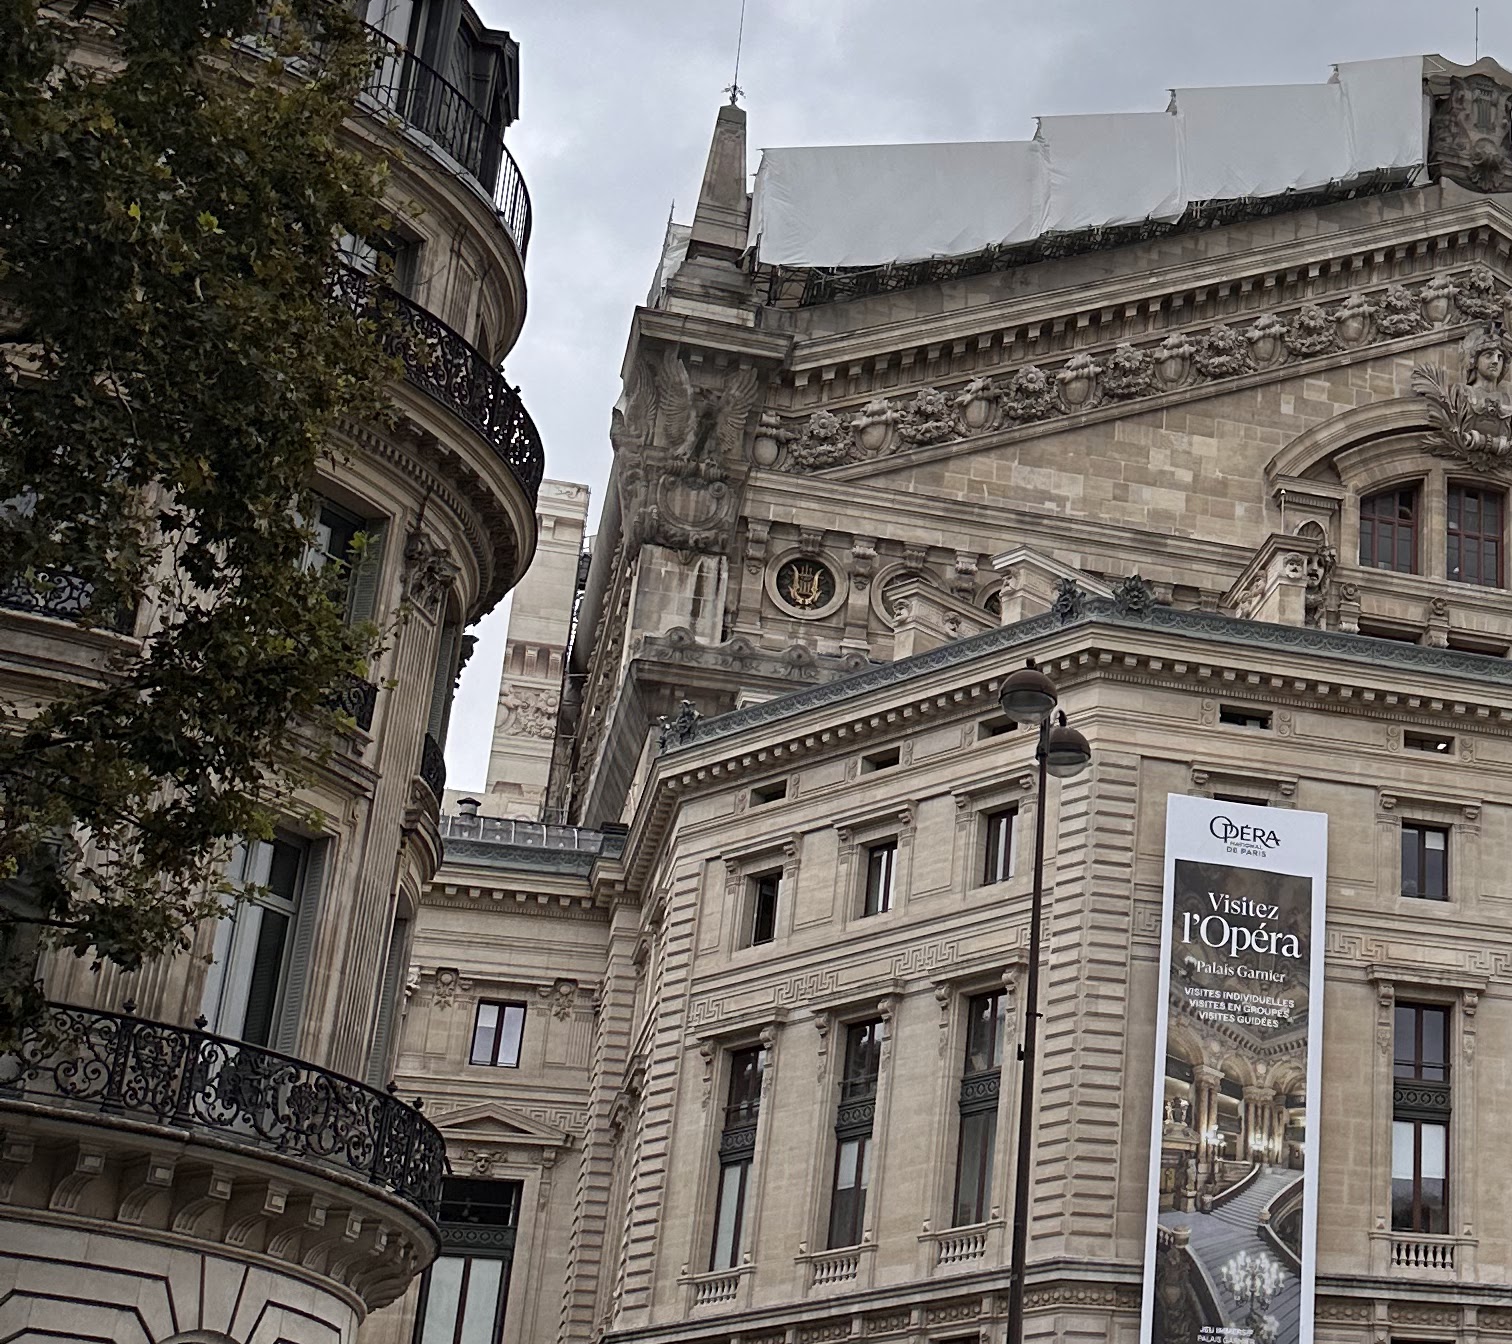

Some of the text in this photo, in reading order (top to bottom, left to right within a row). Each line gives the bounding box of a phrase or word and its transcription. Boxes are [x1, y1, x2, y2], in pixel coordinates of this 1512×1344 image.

[1241, 848, 1267, 858] PARIS
[1208, 892, 1279, 920] Visitez
[1197, 961, 1286, 982] Palais Garnier
[1185, 987, 1295, 1008] VISITES INDIVIDUELLES
[1189, 999, 1290, 1019] VISITES EN GROUPES
[1199, 1011, 1235, 1023] VISITES
